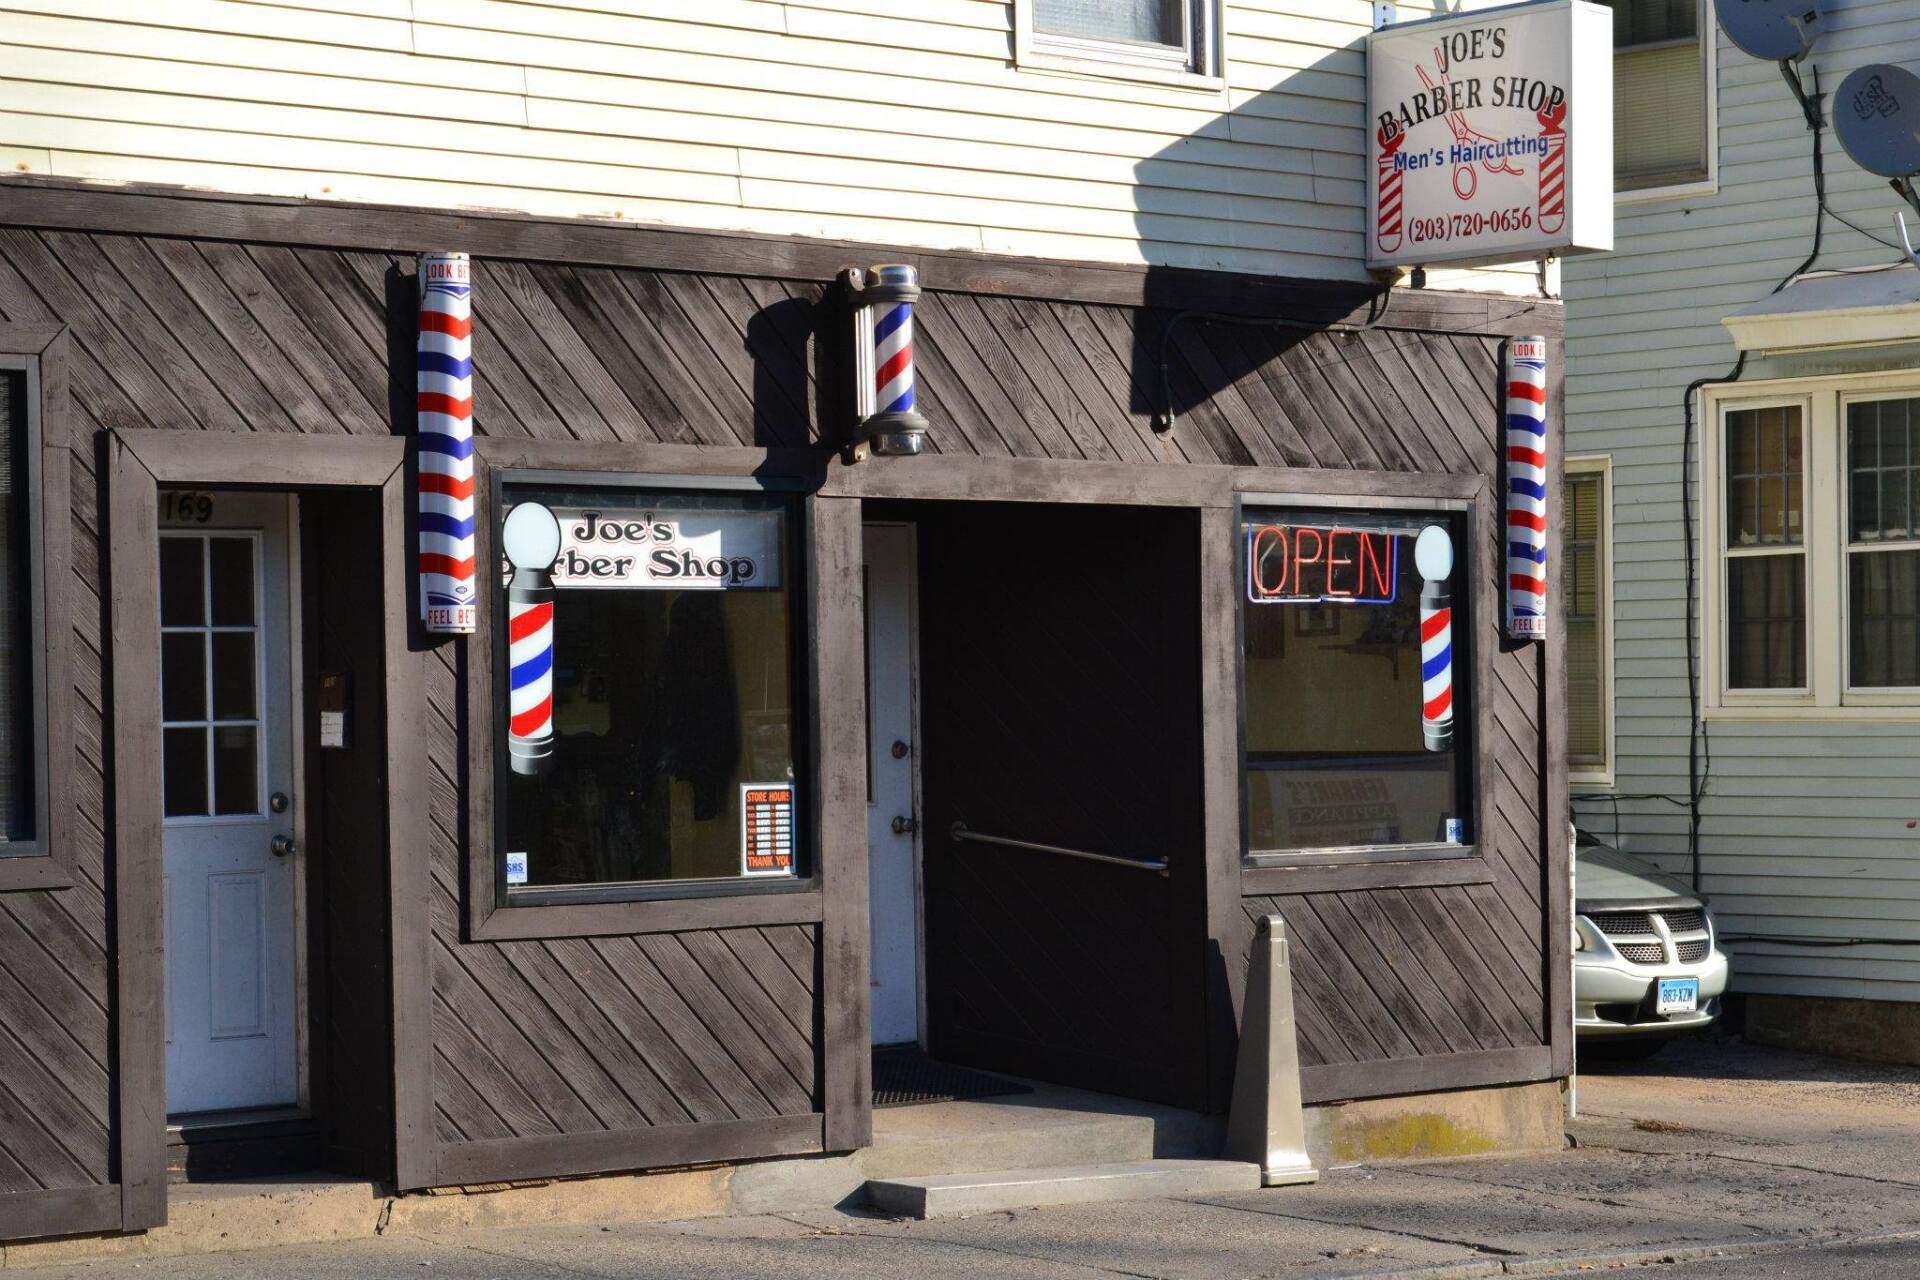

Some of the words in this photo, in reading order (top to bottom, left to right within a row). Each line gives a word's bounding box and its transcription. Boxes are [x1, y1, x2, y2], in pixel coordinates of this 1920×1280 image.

[1440, 27, 1506, 74] JOE'S
[1378, 78, 1483, 143] BARBER
[1492, 76, 1565, 117] SHOP
[1392, 147, 1444, 172] Men's
[1450, 134, 1549, 164] Haircutting
[1408, 207, 1532, 246] (203)720-0656
[426, 263, 453, 278] LOOK
[1514, 344, 1535, 356] LOOK
[165, 494, 213, 523] 169
[573, 511, 674, 542] Joe's
[649, 549, 755, 584] Shop
[1253, 525, 1391, 597] OPEN
[428, 609, 452, 624] FEEL
[1513, 618, 1533, 631] FEEL
[747, 791, 767, 802] STORE
[769, 791, 790, 802] HOURS
[506, 862, 524, 873] SHS
[748, 856, 773, 868] THANK
[775, 855, 791, 867] YOU
